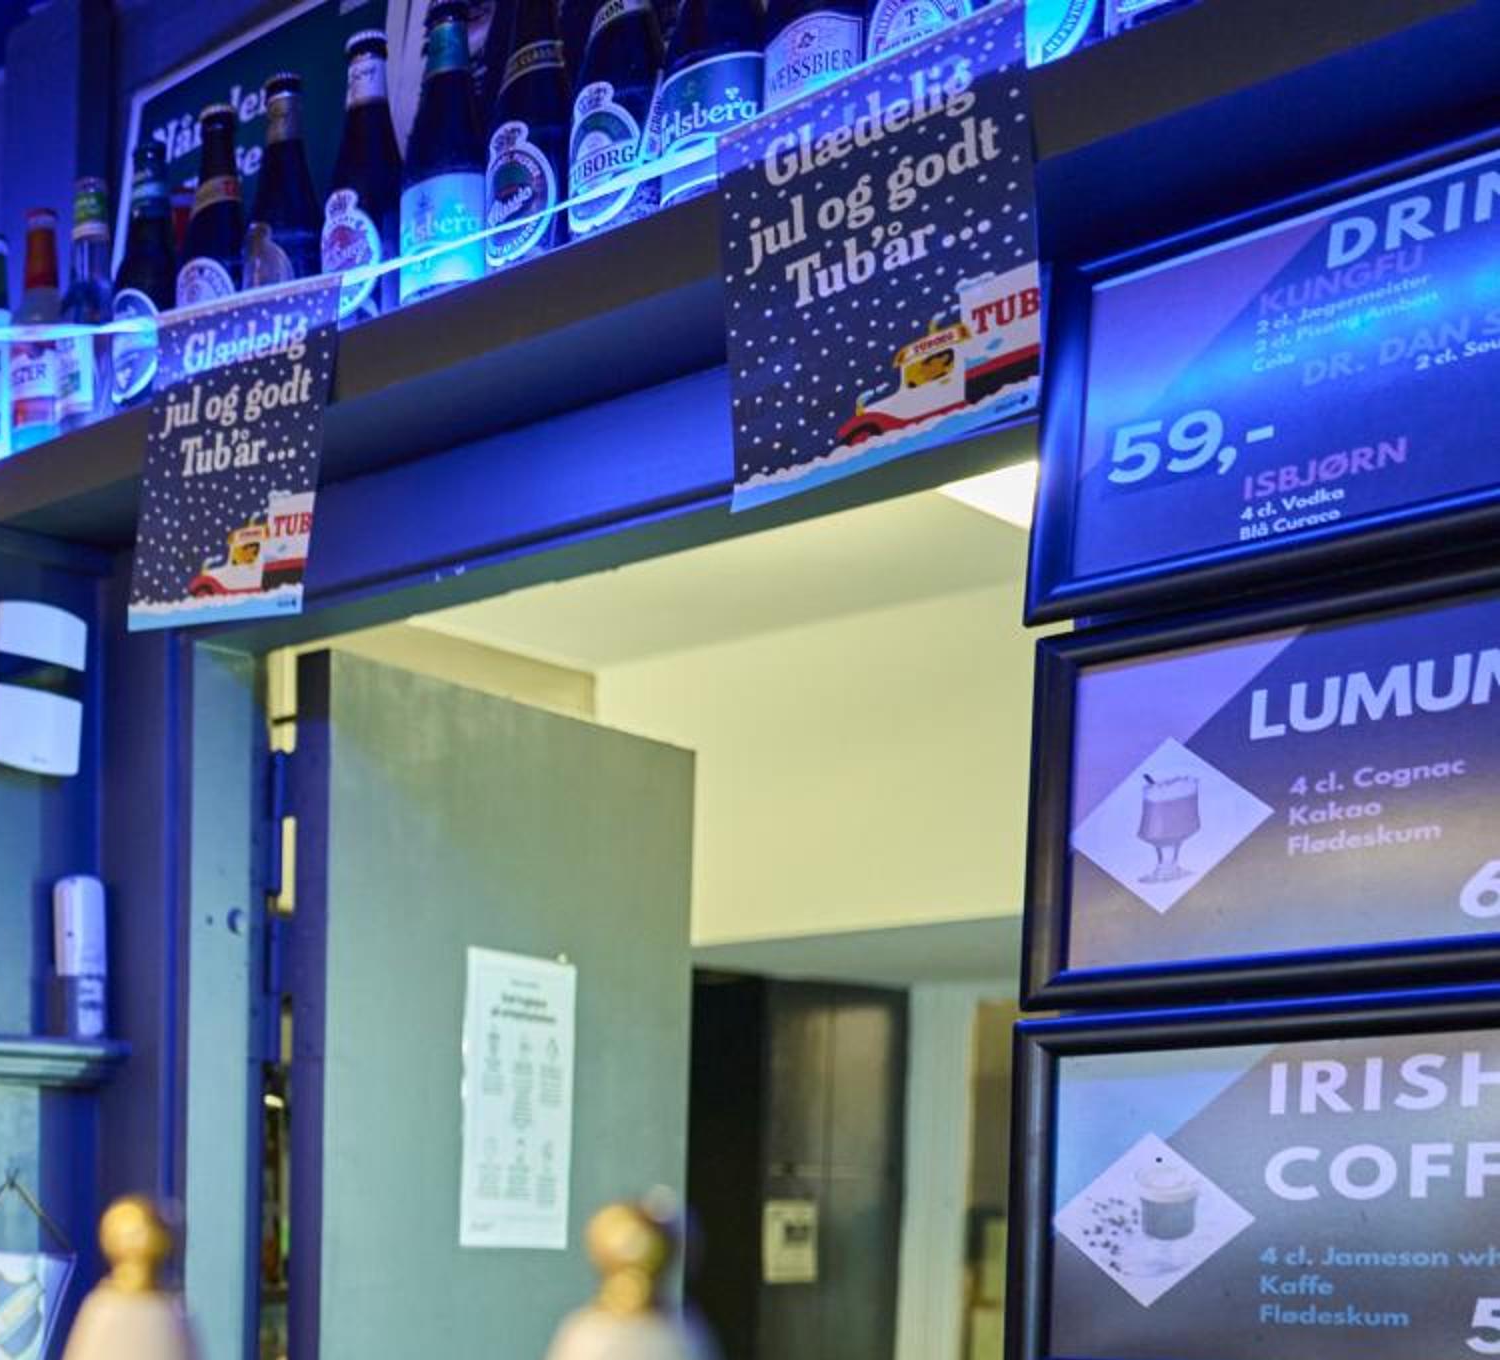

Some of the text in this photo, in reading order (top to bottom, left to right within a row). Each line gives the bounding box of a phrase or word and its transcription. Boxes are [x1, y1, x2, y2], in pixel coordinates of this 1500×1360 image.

[762, 57, 977, 189] Glædelig
[744, 117, 1004, 276] jul og godt
[1257, 243, 1425, 318] KUNGFU
[1255, 318, 1270, 337] 2
[1272, 311, 1294, 331] cl.
[182, 314, 308, 374] Glædelig
[1253, 338, 1268, 355] 2
[1302, 349, 1367, 387] DR.
[1379, 316, 1472, 366] DAN
[1414, 355, 1432, 371] 2
[1433, 348, 1459, 367] cl.
[159, 367, 314, 440] jul og godt
[1106, 408, 1276, 487] 59,-
[1242, 436, 1409, 503] ISBJØRN
[1240, 486, 1346, 522] 4 cl. Vodka
[1239, 521, 1270, 542] Blå
[1289, 757, 1468, 797] 4 cl. Cognac
[1287, 798, 1383, 828] Kakao
[1287, 822, 1443, 857] Flødeskum
[1258, 1246, 1278, 1267] 4
[1283, 1245, 1316, 1268] cl.
[1320, 1246, 1449, 1270] Jameson
[1259, 1275, 1335, 1298] Kaffe
[1258, 1304, 1411, 1329] Flødeskum
